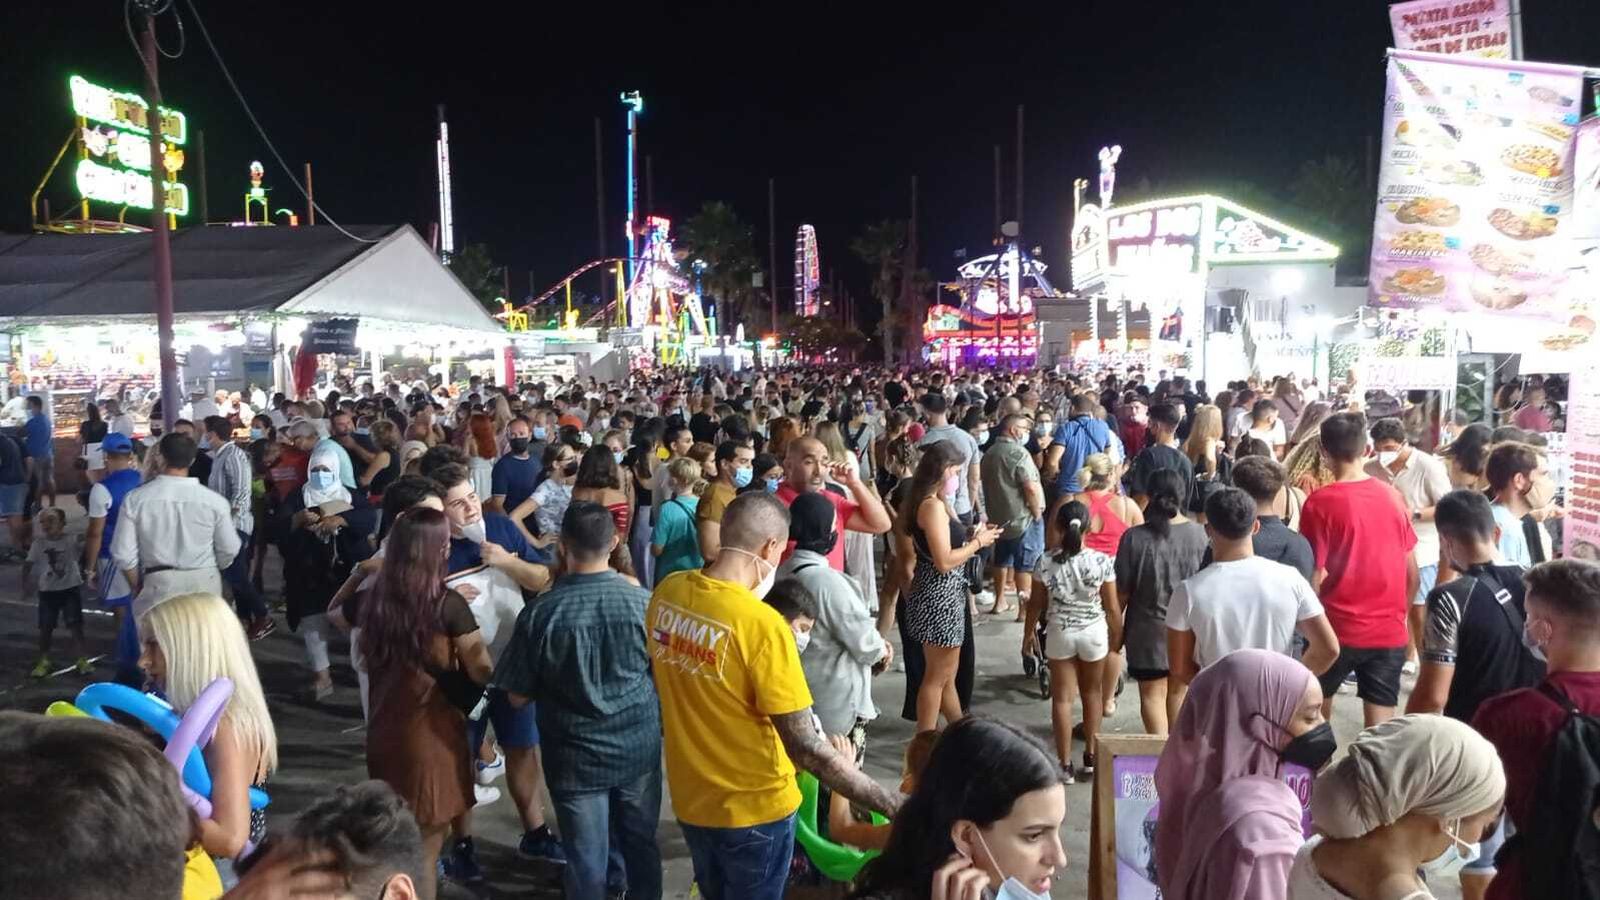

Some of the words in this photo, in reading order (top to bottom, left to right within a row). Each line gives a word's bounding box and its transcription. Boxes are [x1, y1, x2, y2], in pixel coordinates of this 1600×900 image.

[1402, 7, 1449, 27] PATATA
[1453, 0, 1495, 19] ASADA
[1410, 18, 1480, 42] COMPLETA
[1445, 39, 1463, 54] DE
[1466, 31, 1507, 51] KEBAB
[655, 605, 725, 651] TOMMY
[672, 636, 717, 666] JEANS
